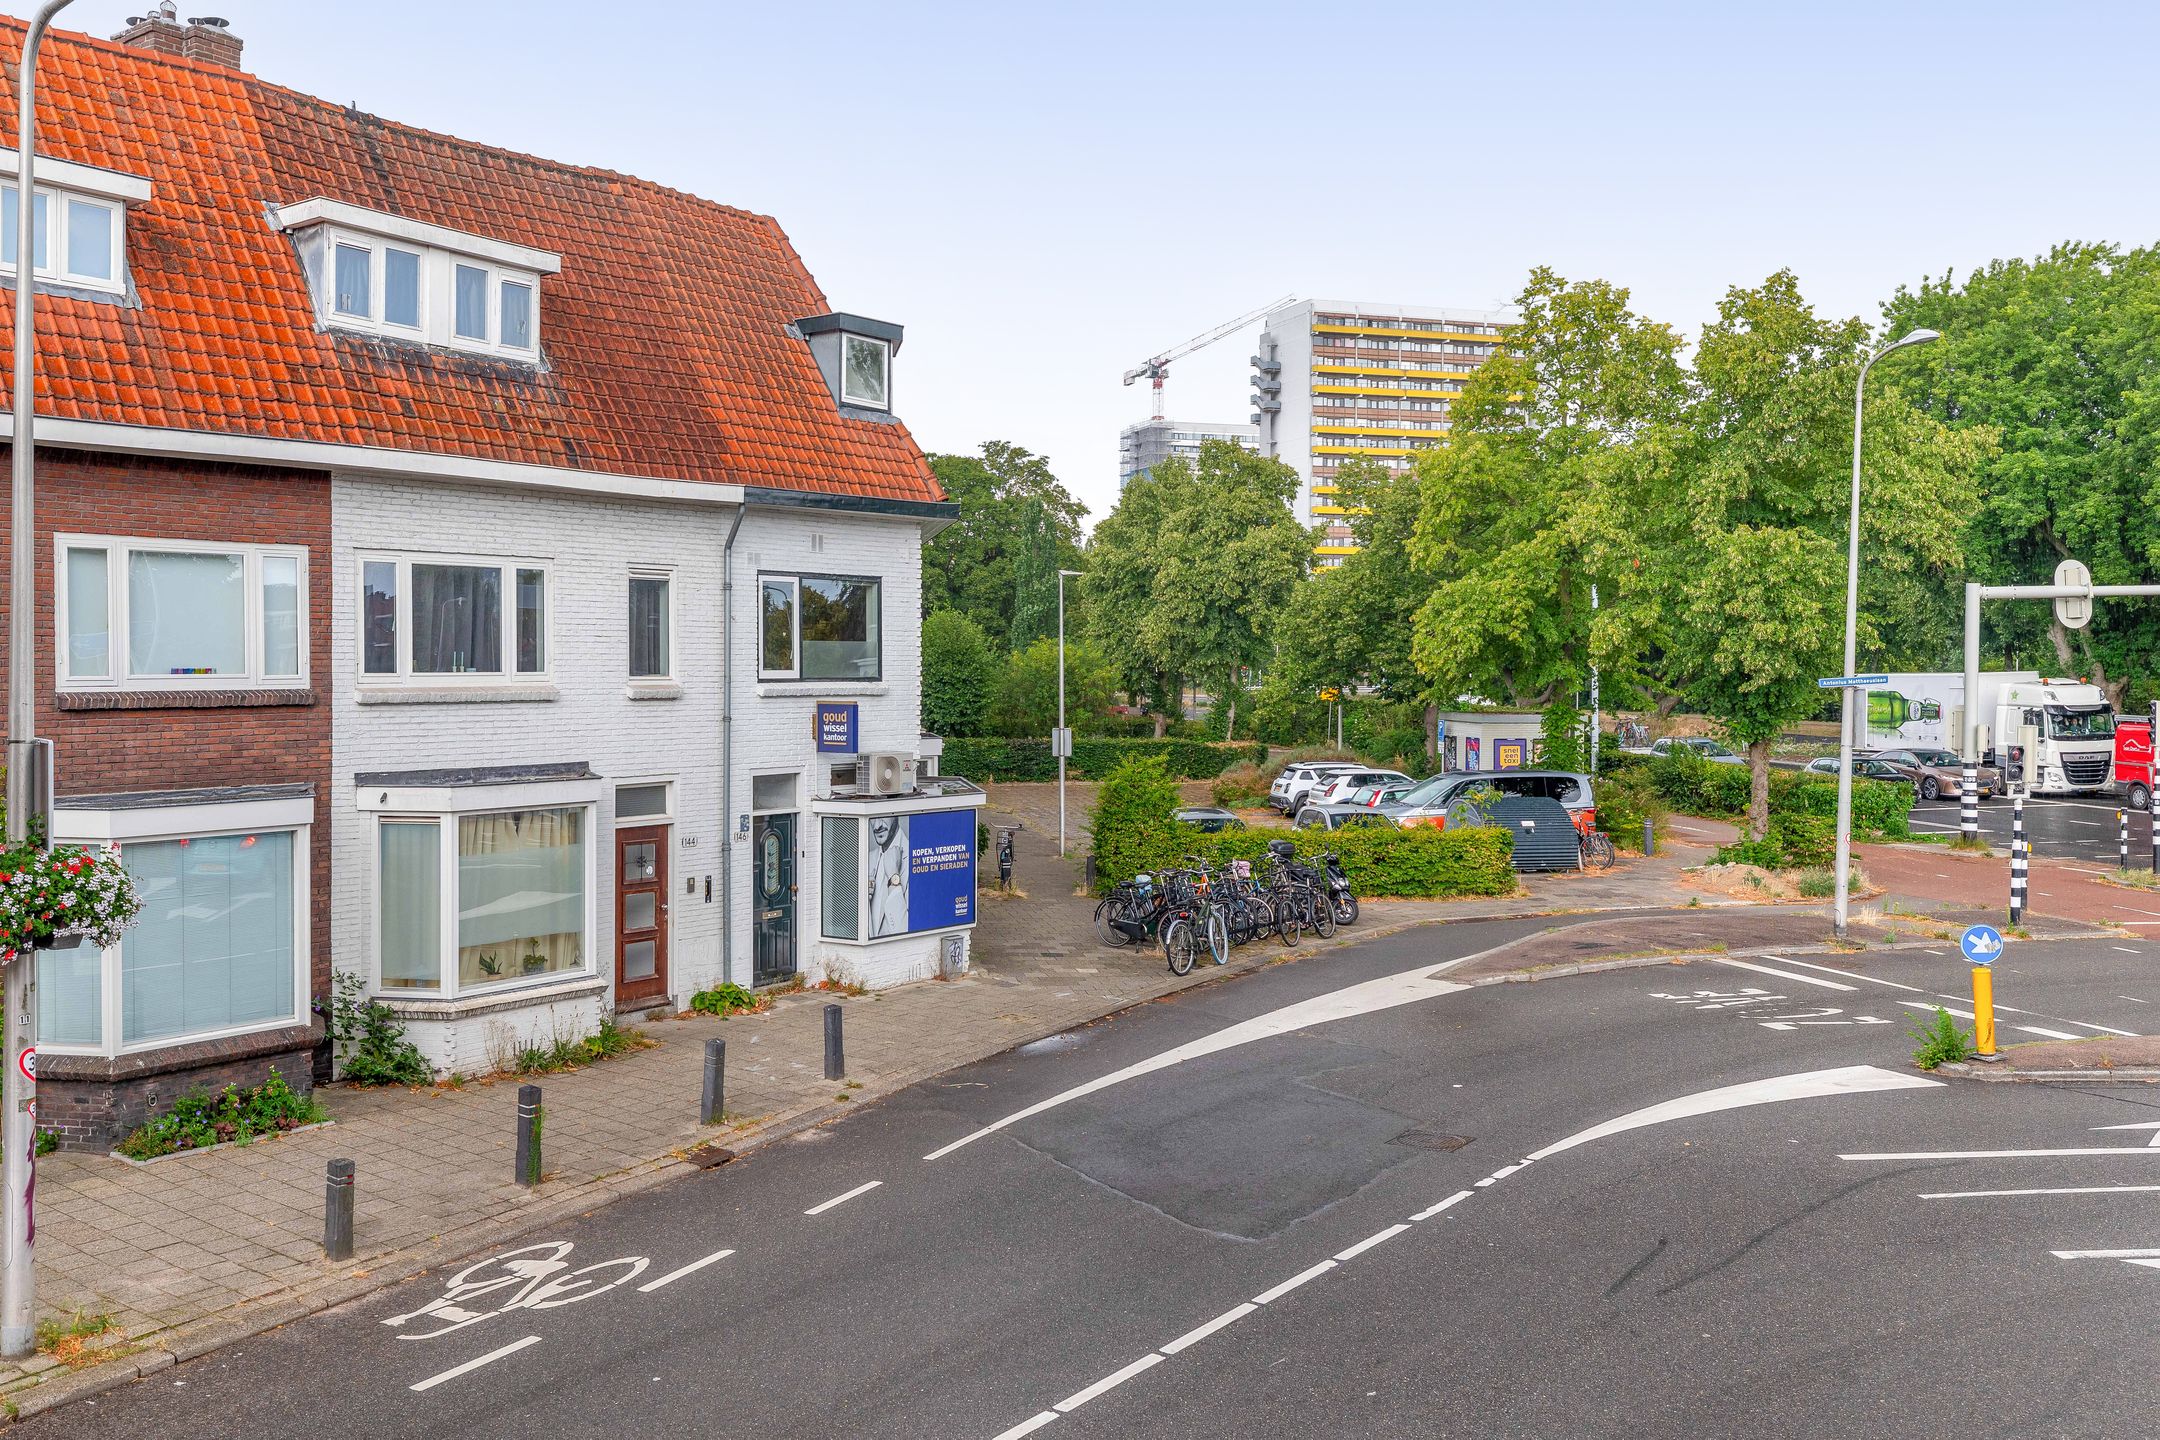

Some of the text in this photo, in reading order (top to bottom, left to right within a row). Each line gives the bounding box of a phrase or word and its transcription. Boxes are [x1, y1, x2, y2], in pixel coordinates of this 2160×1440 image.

[823, 711, 847, 724] goud
[823, 723, 847, 732] wissel
[823, 733, 847, 741] kantoor
[736, 833, 747, 841] 146
[685, 838, 696, 846] 144
[912, 844, 966, 857] KOPEN, VERKOPEN
[922, 853, 957, 864] VERPANDEN
[959, 852, 970, 860] VAN
[912, 861, 968, 874] GOUD EN SIERADEN
[20, 1015, 30, 1024] 11
